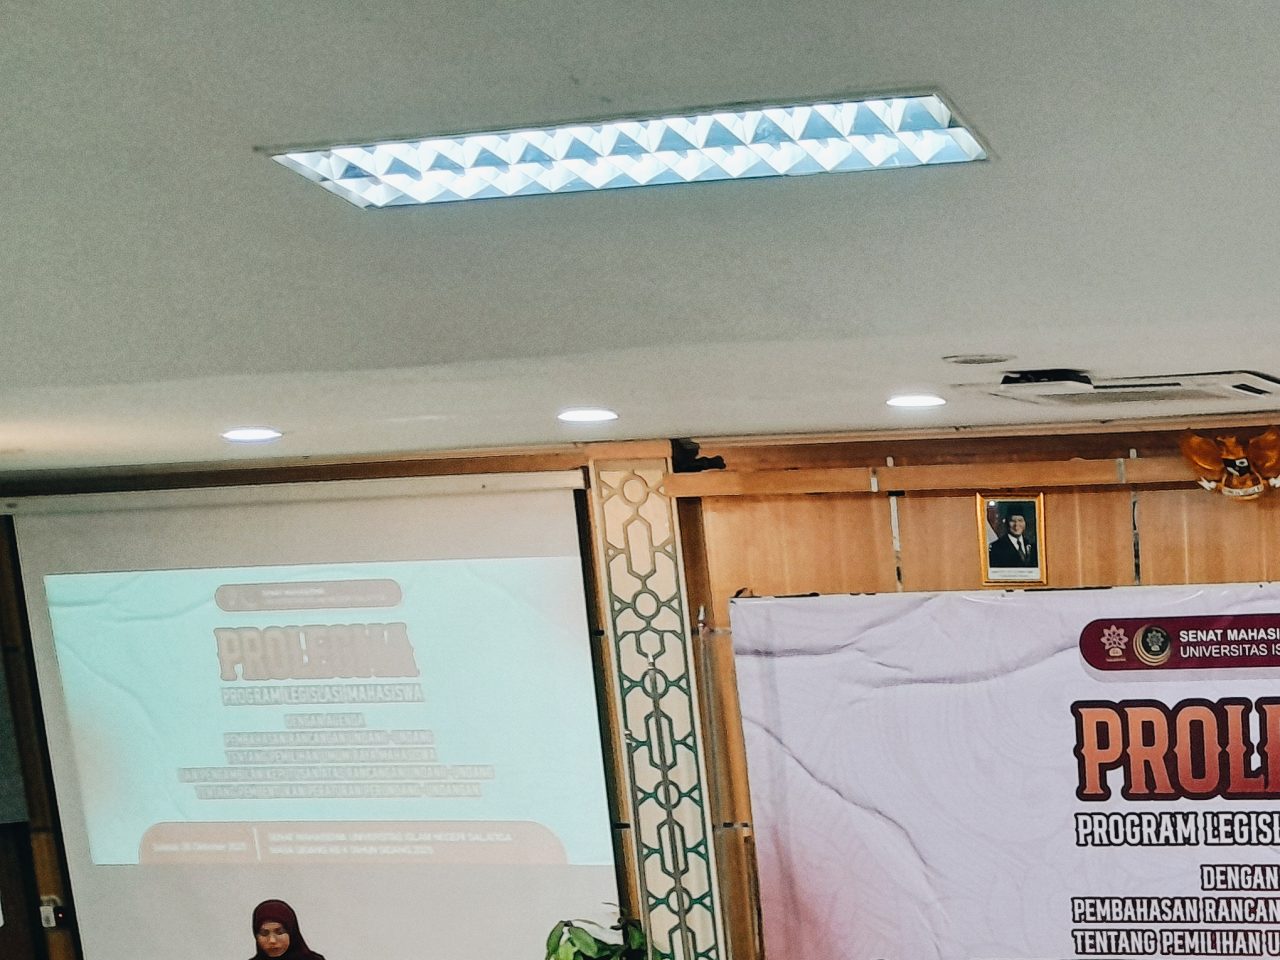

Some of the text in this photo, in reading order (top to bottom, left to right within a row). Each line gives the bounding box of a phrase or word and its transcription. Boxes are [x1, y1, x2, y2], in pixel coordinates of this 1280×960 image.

[1179, 629, 1224, 643] SENAT
[1180, 643, 1268, 658] UNIVERSITAS
[1075, 812, 1200, 846] PROGRAM
[1200, 864, 1280, 891] DENGAN
[1071, 897, 1201, 923] PEMBAHASAN
[1072, 929, 1159, 955] TENTANG
[1159, 929, 1263, 956] PEMILIHAN
